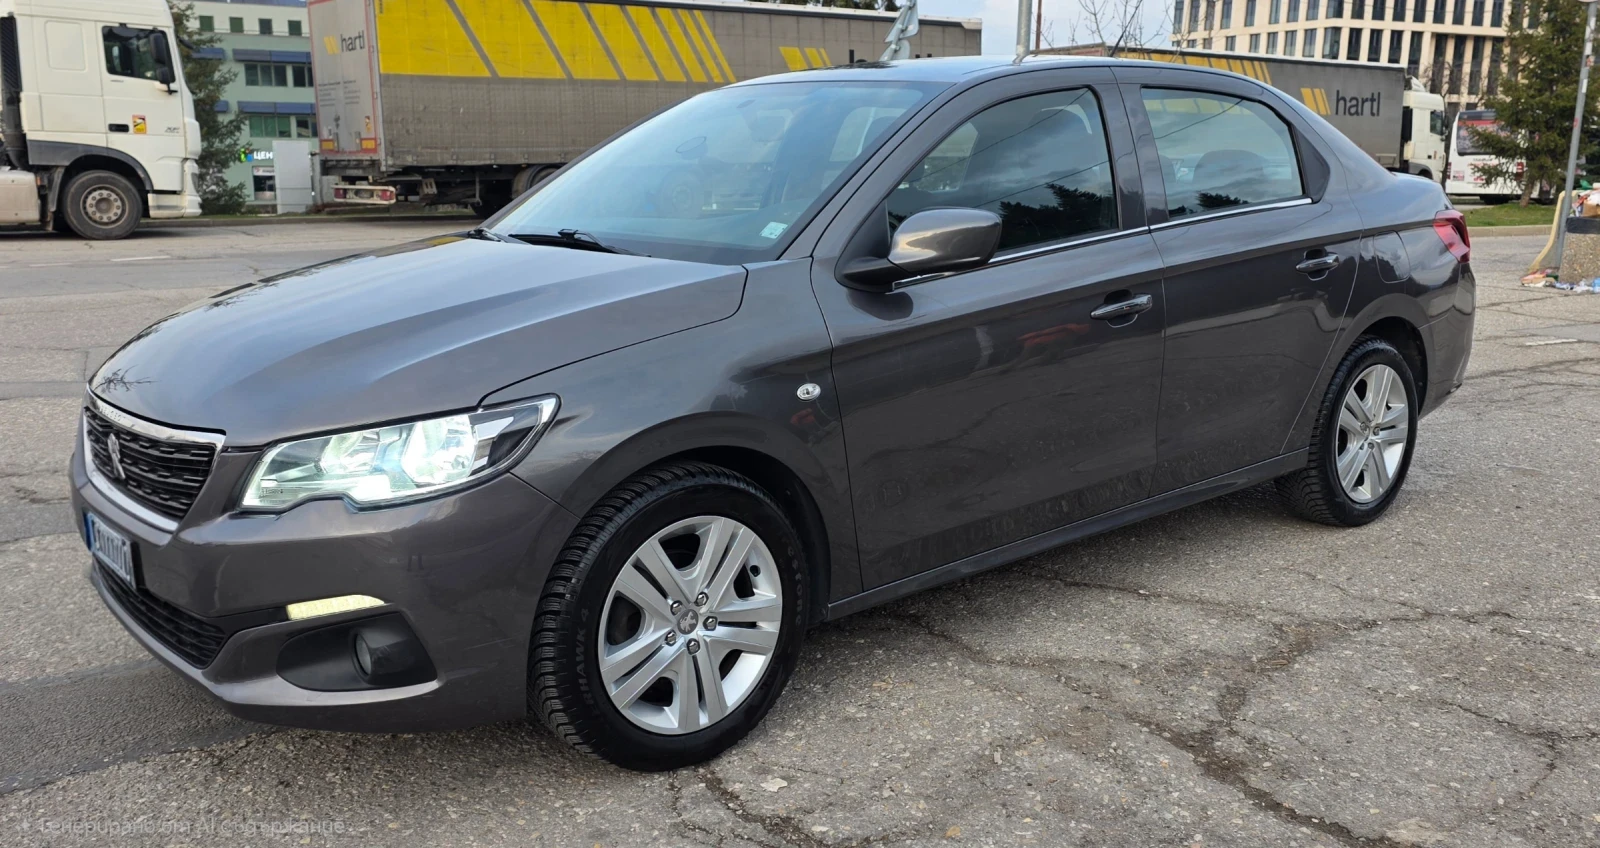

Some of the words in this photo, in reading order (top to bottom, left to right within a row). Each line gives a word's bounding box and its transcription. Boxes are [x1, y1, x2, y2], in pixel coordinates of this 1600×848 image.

[340, 30, 366, 52] hartl
[1335, 89, 1381, 117] hartl
[253, 150, 273, 160] ЦЕН
